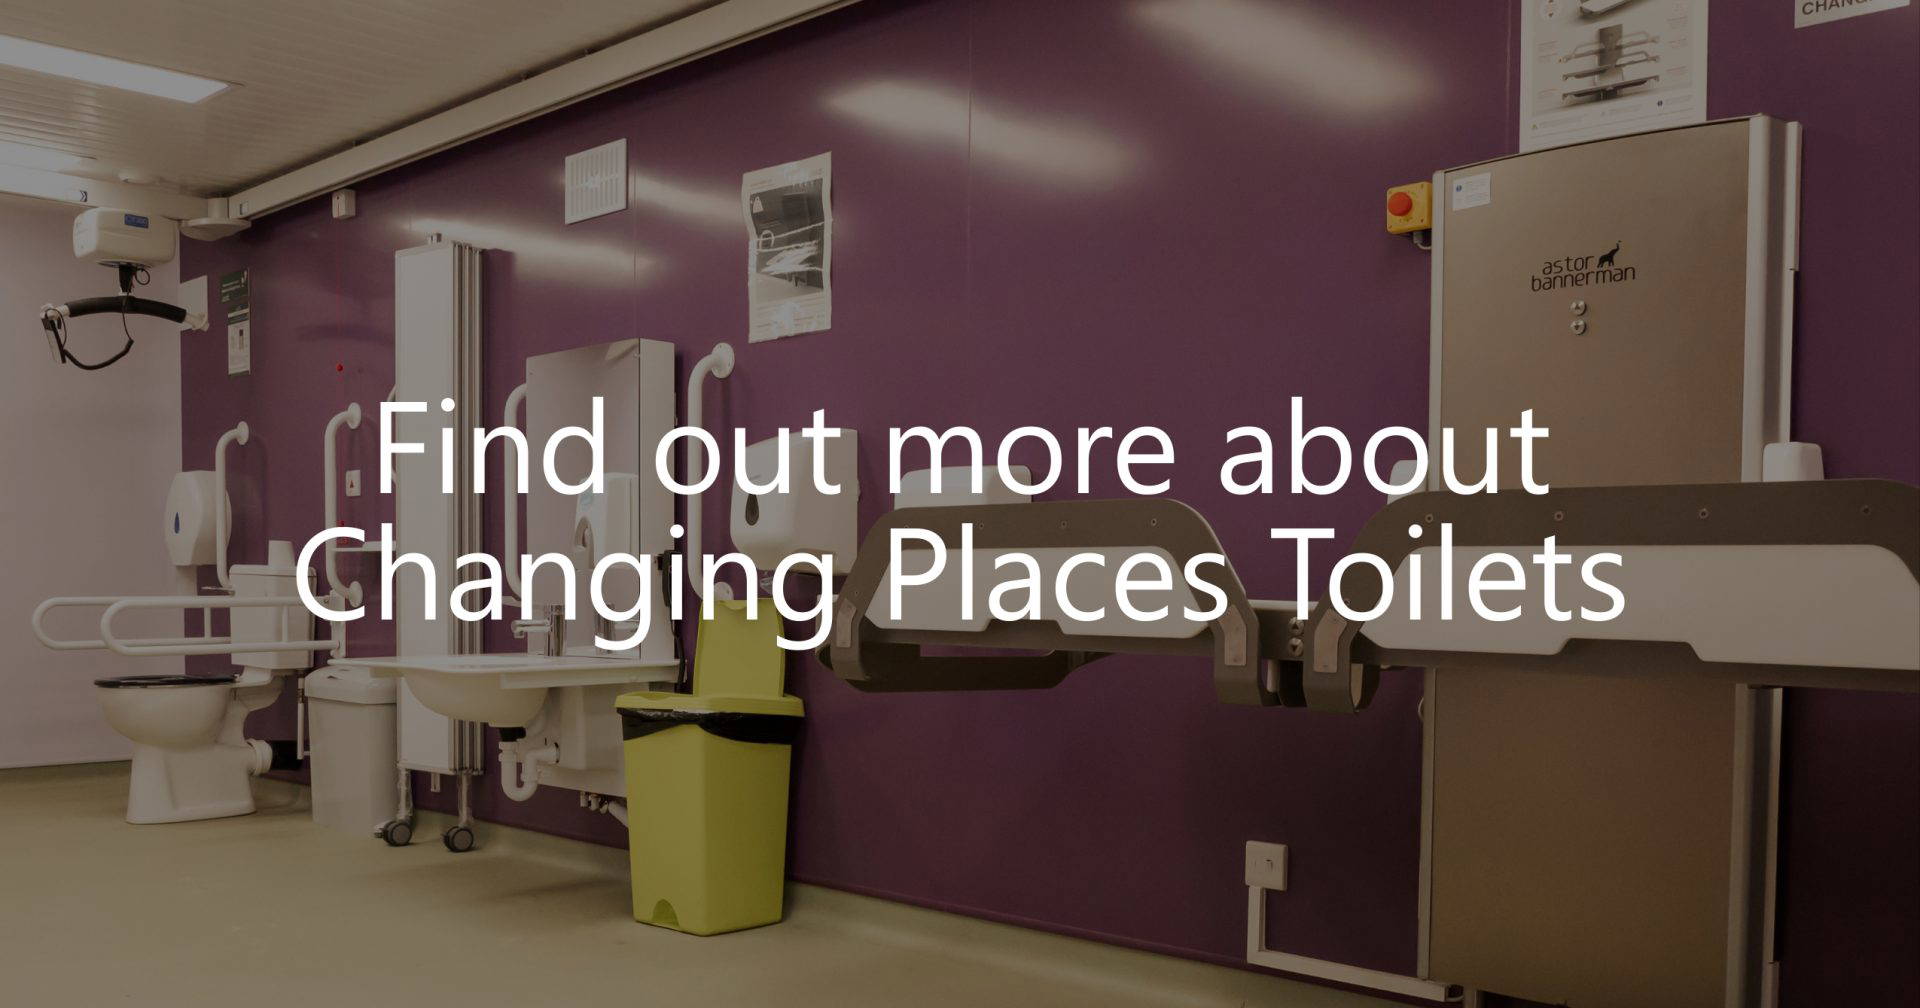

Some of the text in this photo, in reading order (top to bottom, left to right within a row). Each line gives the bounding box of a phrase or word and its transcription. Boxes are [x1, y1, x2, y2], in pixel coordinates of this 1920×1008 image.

[1801, 0, 1873, 16] CHAN
[1542, 255, 1594, 275] astor
[1531, 265, 1636, 292] bannerman
